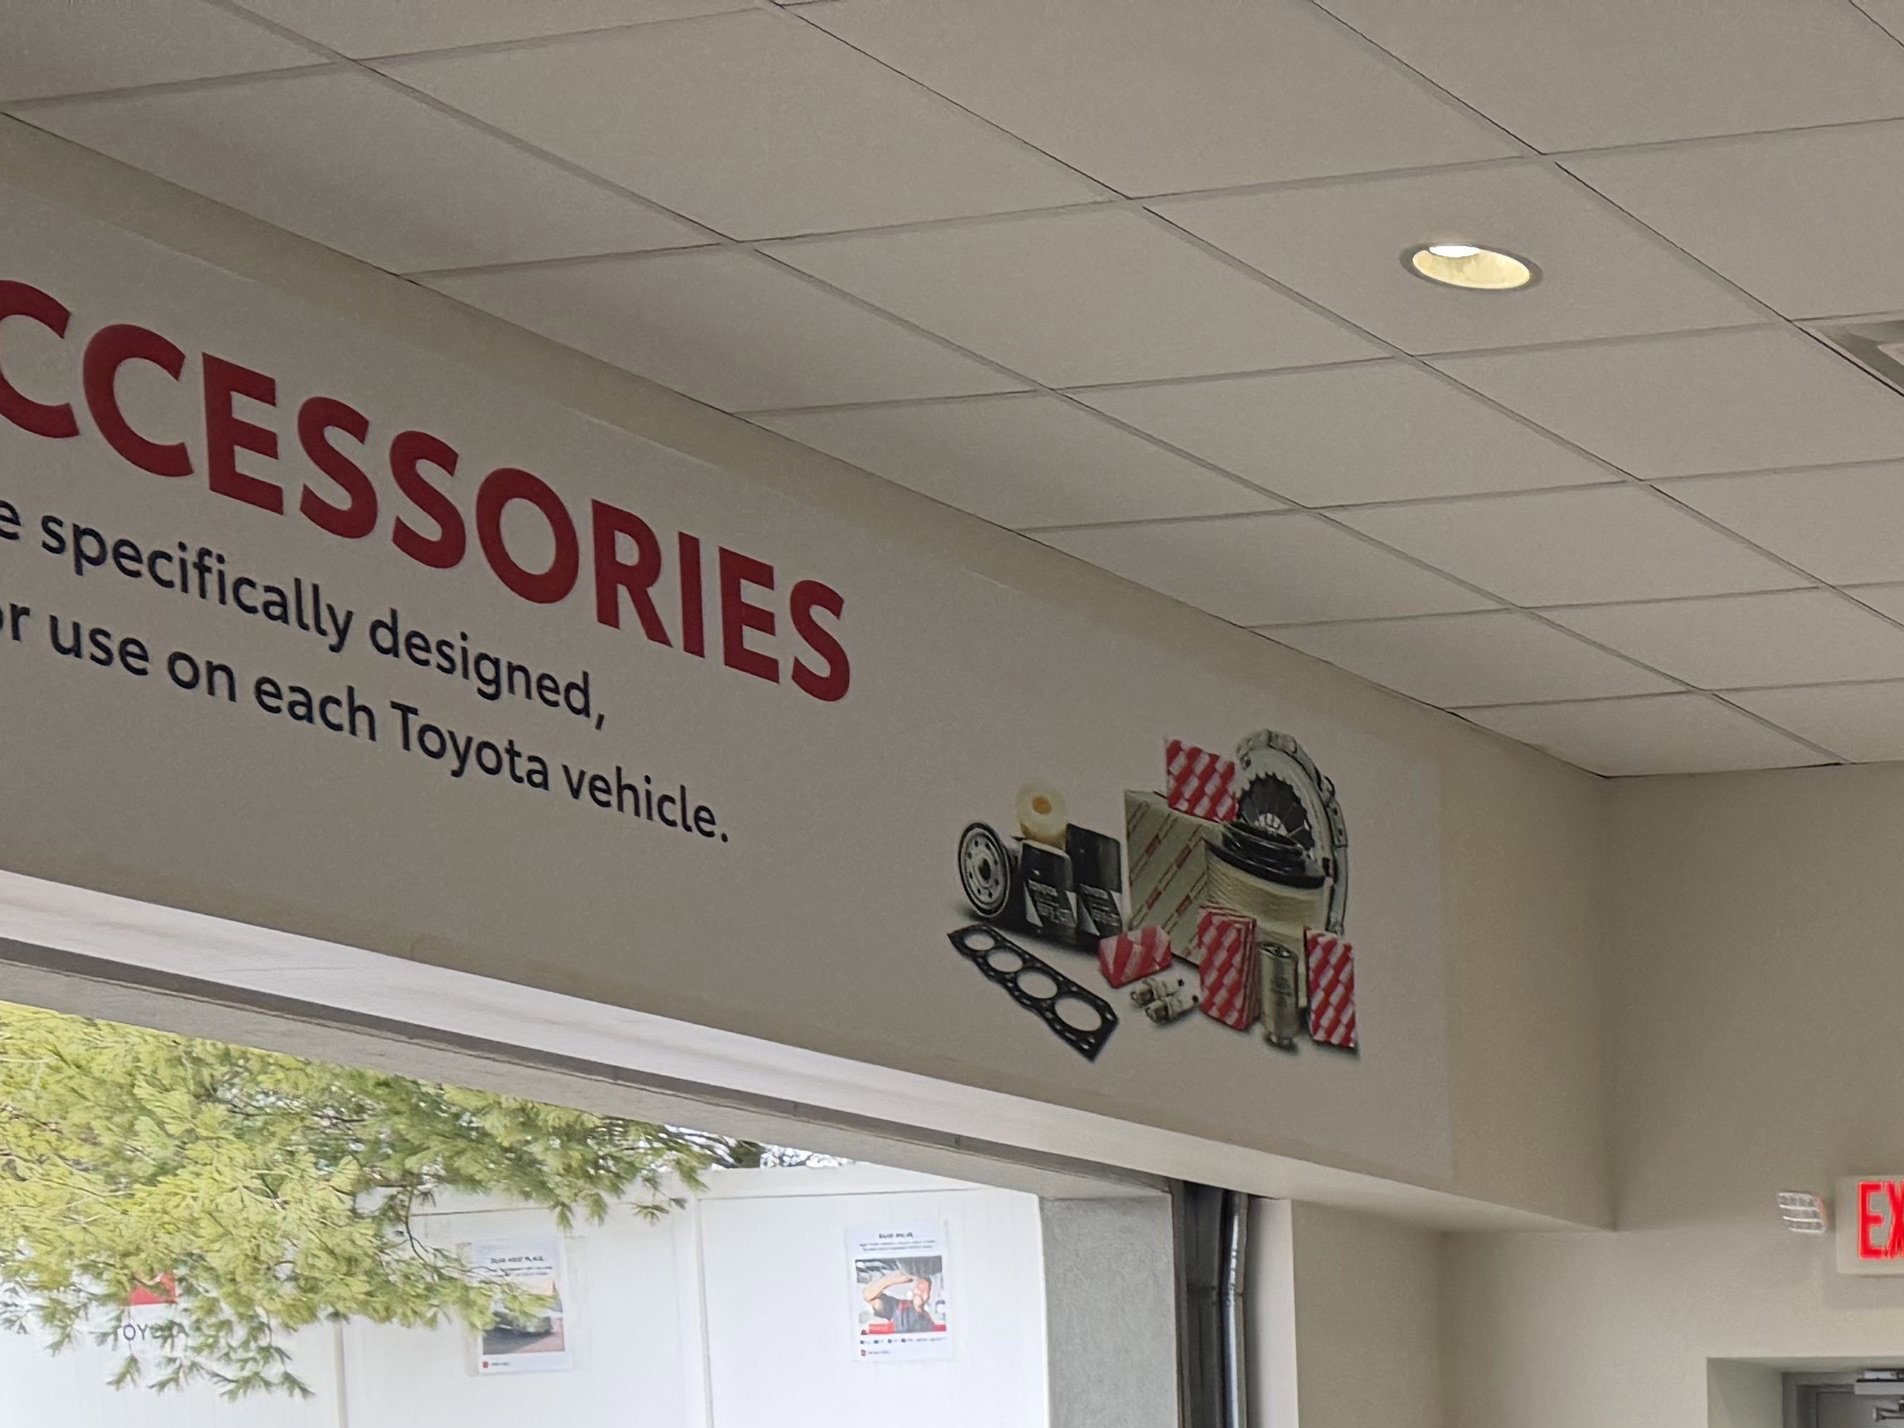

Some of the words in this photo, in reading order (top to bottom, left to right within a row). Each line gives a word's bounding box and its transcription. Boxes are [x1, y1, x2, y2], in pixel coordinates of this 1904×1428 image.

[41, 515, 354, 653] specifically
[369, 608, 605, 730] designed,
[49, 614, 149, 676] use
[168, 650, 237, 703] on
[254, 676, 377, 742] each
[390, 700, 550, 791] Toyota
[562, 764, 729, 843] vehicle.
